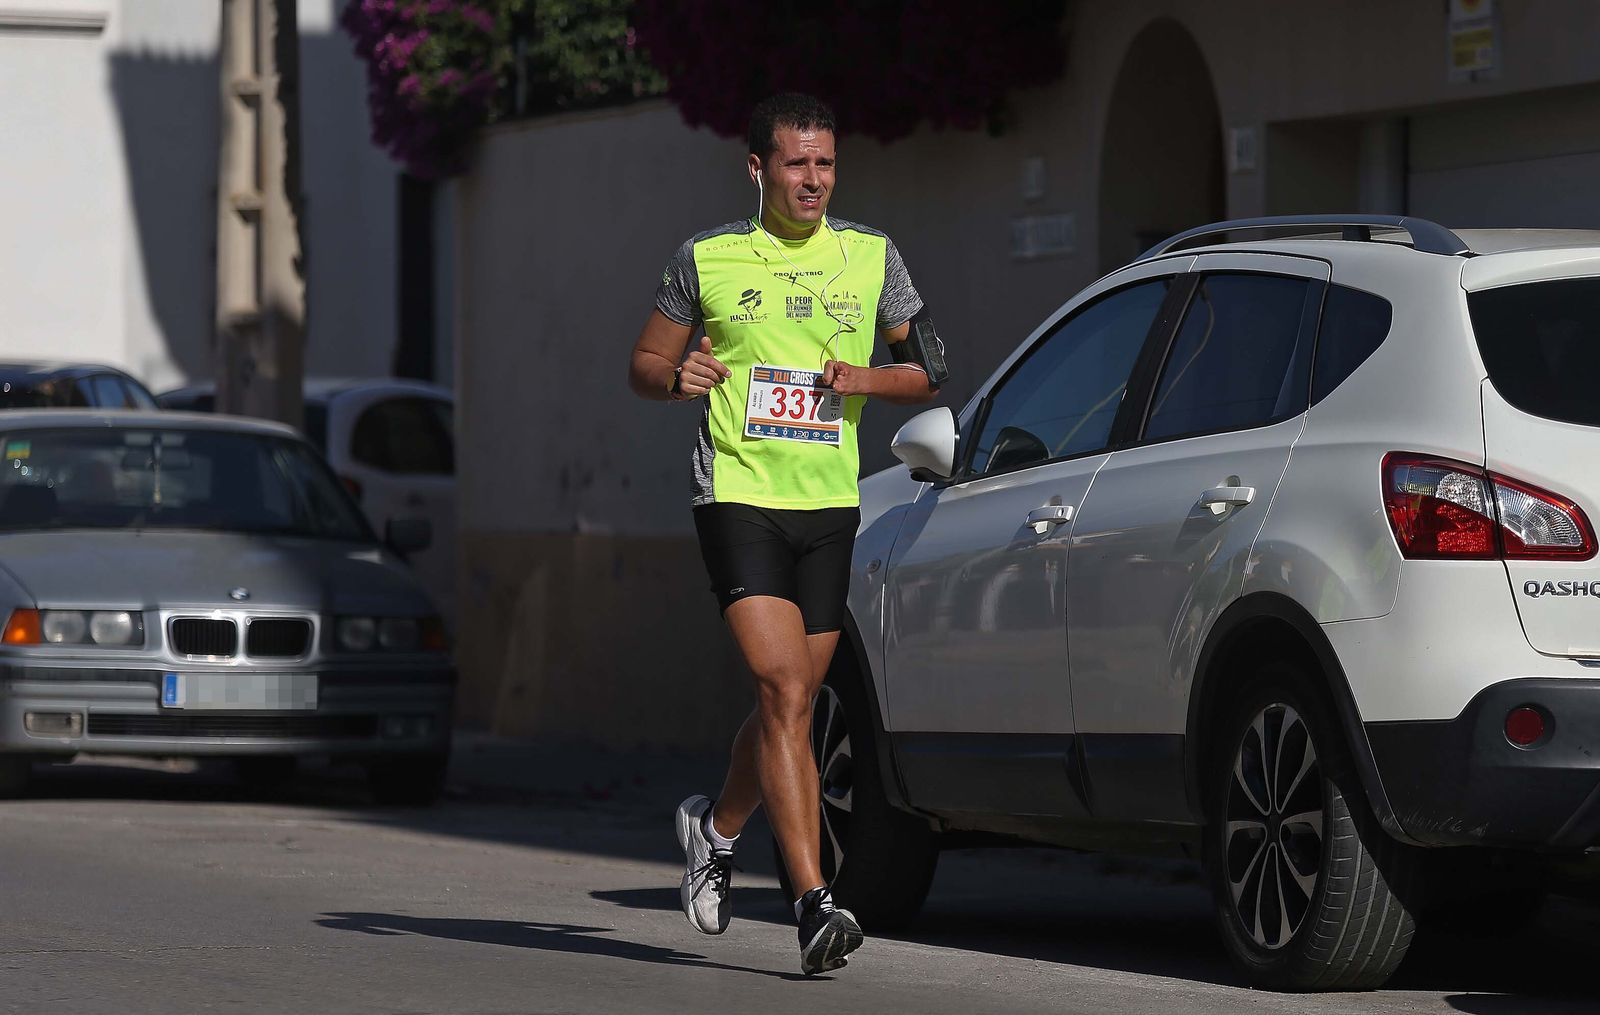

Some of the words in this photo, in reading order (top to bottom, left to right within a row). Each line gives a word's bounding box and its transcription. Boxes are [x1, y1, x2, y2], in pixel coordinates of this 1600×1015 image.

[785, 296, 793, 305] EL
[794, 296, 812, 305] PEOR
[790, 372, 814, 385] CROSS
[769, 386, 824, 420] 337
